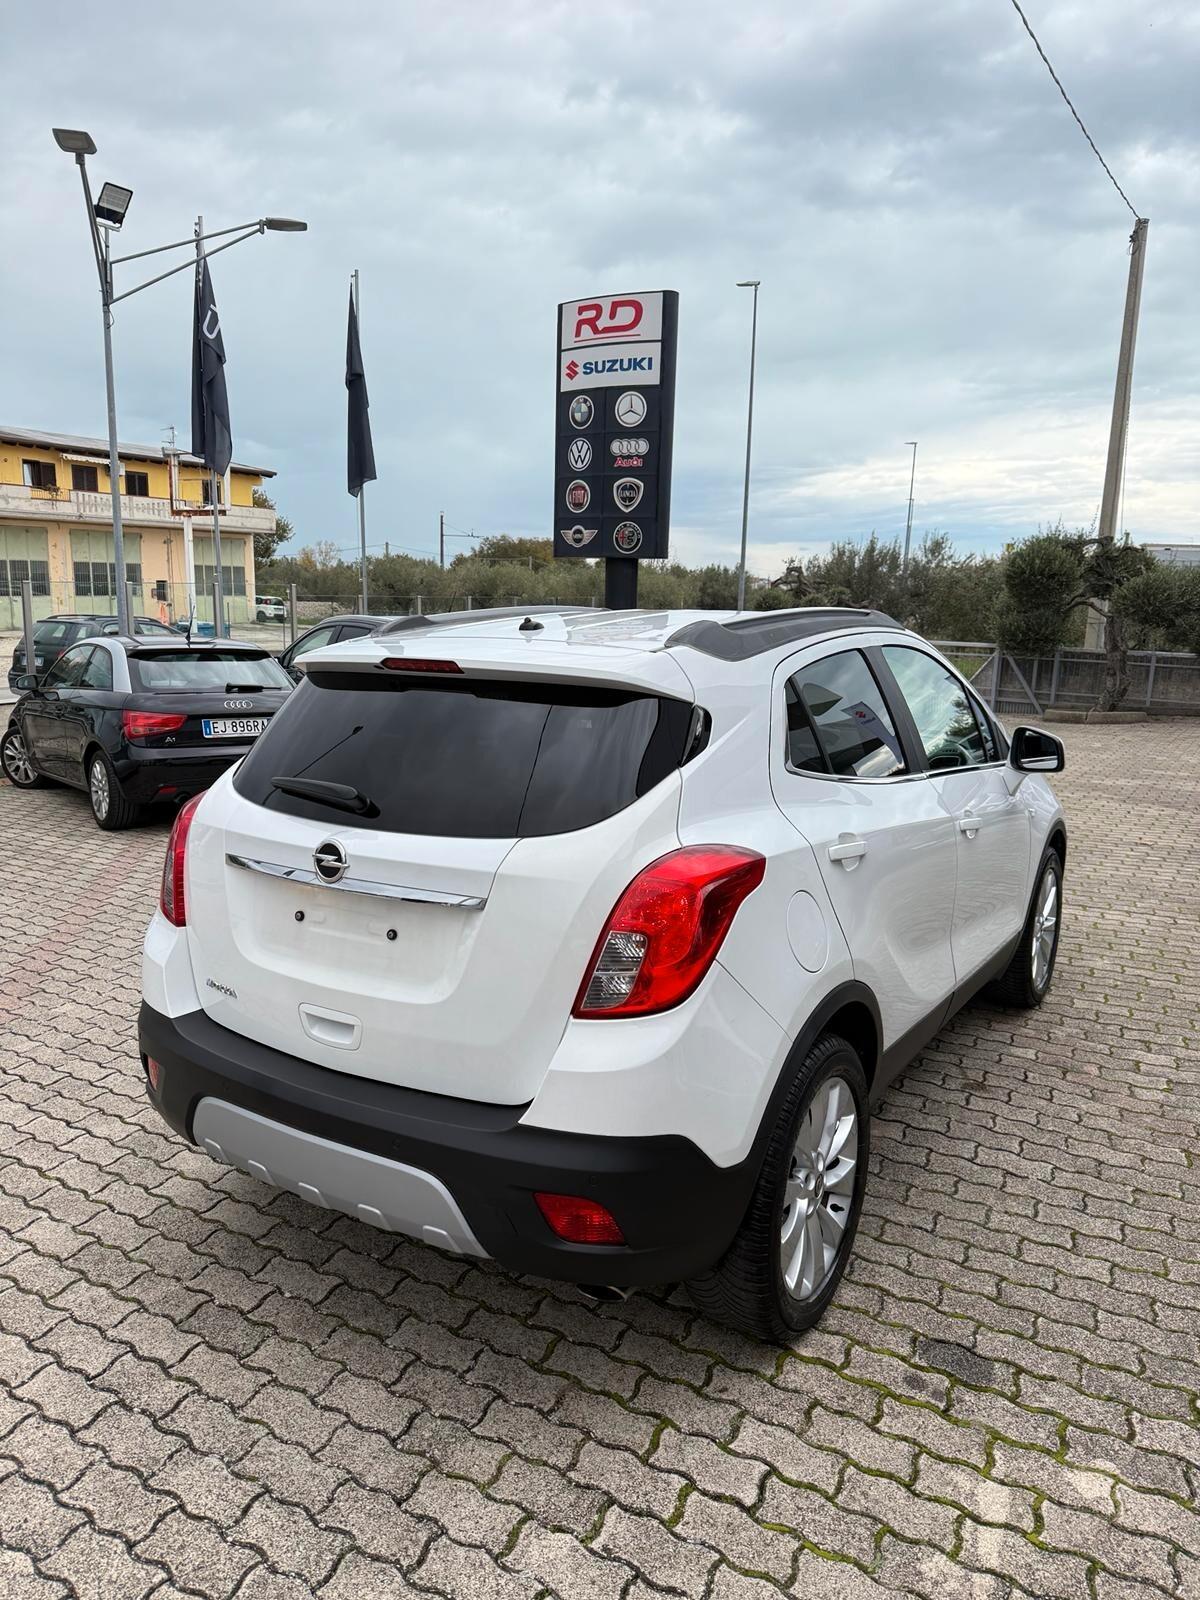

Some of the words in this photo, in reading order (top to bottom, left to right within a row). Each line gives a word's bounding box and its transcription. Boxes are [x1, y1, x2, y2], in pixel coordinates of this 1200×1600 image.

[574, 299, 644, 338] RD
[582, 356, 653, 375] SUZUKI
[614, 456, 643, 467] Audi
